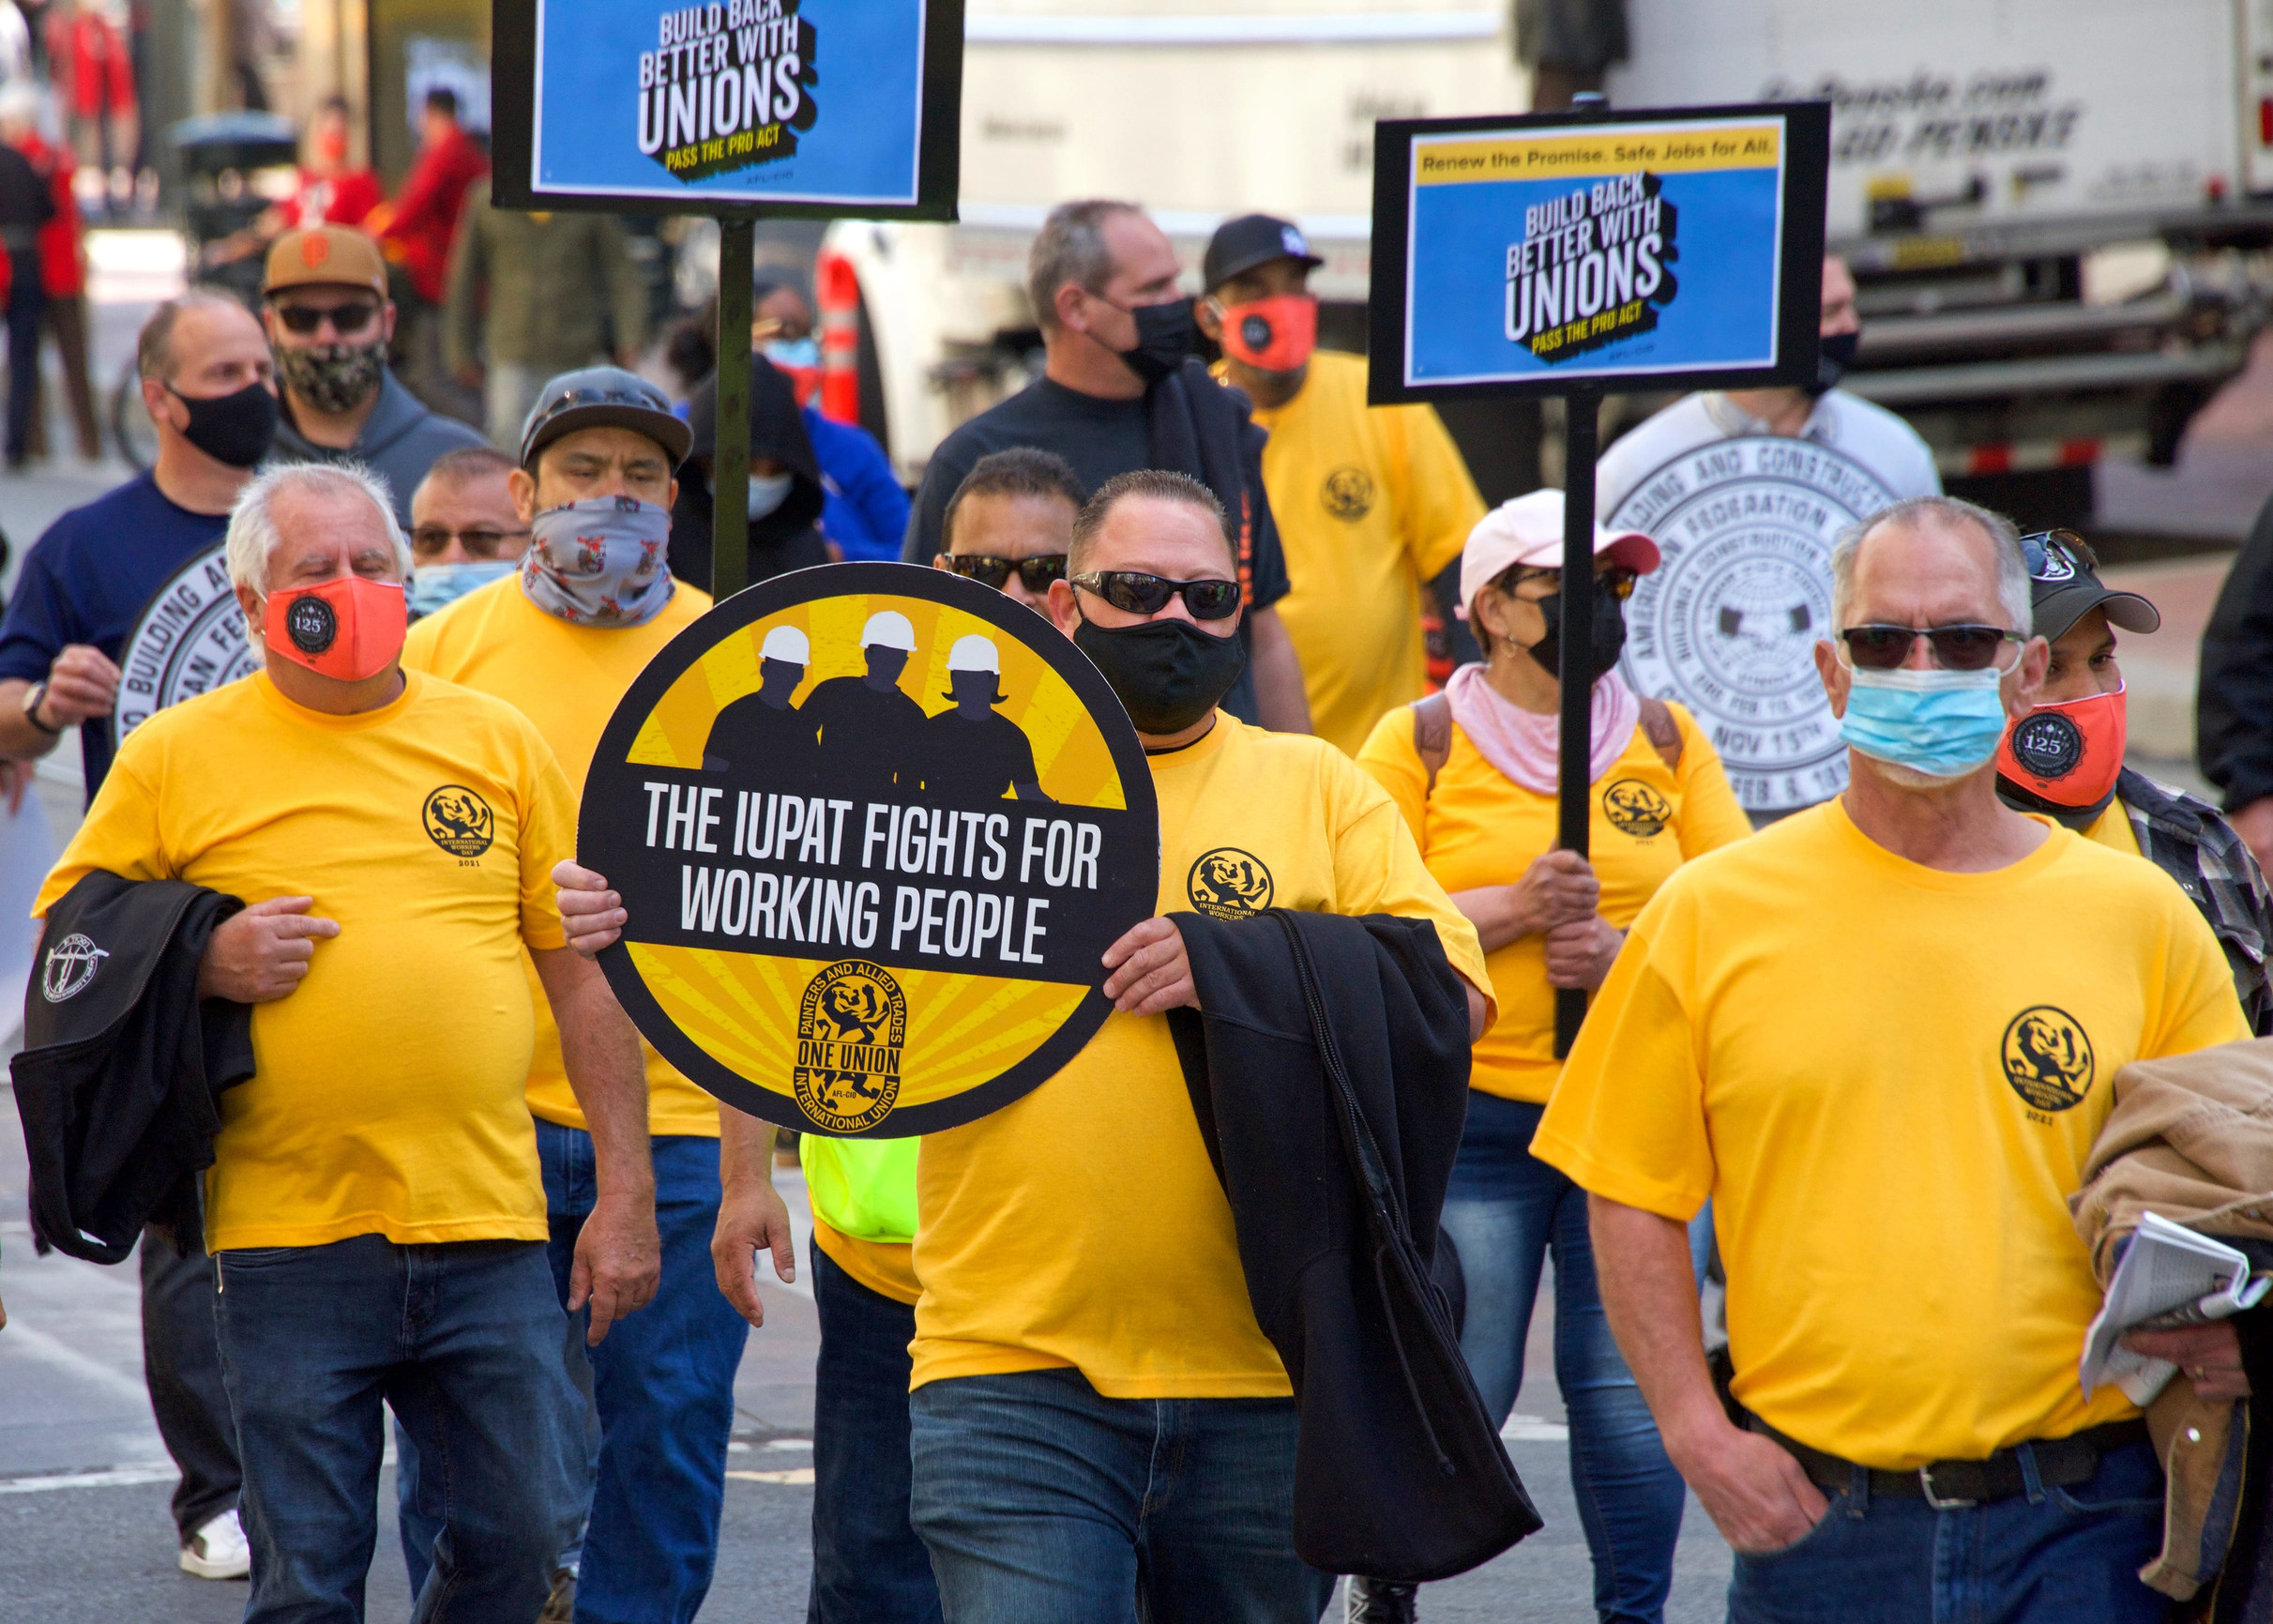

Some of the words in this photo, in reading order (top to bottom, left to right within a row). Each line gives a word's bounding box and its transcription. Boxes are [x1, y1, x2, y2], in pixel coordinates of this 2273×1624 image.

[638, 32, 729, 89] BETTER
[735, 14, 800, 66] WITH
[659, 3, 721, 46] BUILD
[728, 0, 783, 29] BACK
[637, 53, 801, 155] UNIONS
[665, 144, 698, 171] PASS
[701, 138, 725, 164] THE
[728, 130, 754, 158] PRO
[756, 123, 781, 150] ACT
[1422, 155, 1485, 173] Renew
[1491, 151, 1523, 170] the
[1527, 148, 1609, 167] Promise.
[1614, 145, 1657, 163] Safe
[1661, 142, 1706, 161] Jobs
[1710, 141, 1738, 159] for
[1742, 137, 1773, 156] All.
[1525, 189, 1586, 237] BUILD
[1590, 171, 1645, 217] BACK
[1506, 222, 1594, 280] BETTER
[1599, 195, 1661, 250] WITH
[1505, 232, 1663, 341] UNIONS
[1531, 330, 1563, 355] PASS
[1566, 322, 1589, 346] THE
[1591, 313, 1617, 338] PRO
[1618, 299, 1643, 327] ACT
[1694, 448, 1743, 482] AND
[1756, 446, 1886, 517] CONSTRUCT
[1685, 493, 1827, 539] FEDERATION
[127, 584, 201, 697] BUILDING
[295, 616, 321, 633] 125
[1712, 722, 1761, 755] NOV
[2024, 735, 2061, 754] 125
[644, 782, 723, 855] THE
[733, 790, 853, 868] IUPAT
[861, 803, 1009, 883] FIGHTS
[1020, 817, 1102, 890] FOR
[681, 865, 880, 949] WORKING
[890, 887, 1050, 964] PEOPLE
[800, 977, 827, 1035] PAINTERS
[826, 963, 853, 979] AND
[856, 963, 896, 993] ALLIED
[890, 993, 904, 1043] TRADES
[797, 1040, 835, 1068] ONE
[840, 1045, 901, 1075] UNION
[796, 1072, 871, 1130] INTERNATIONAL
[869, 1080, 899, 1120] UNION
[832, 1090, 856, 1100] AFL-CIO
